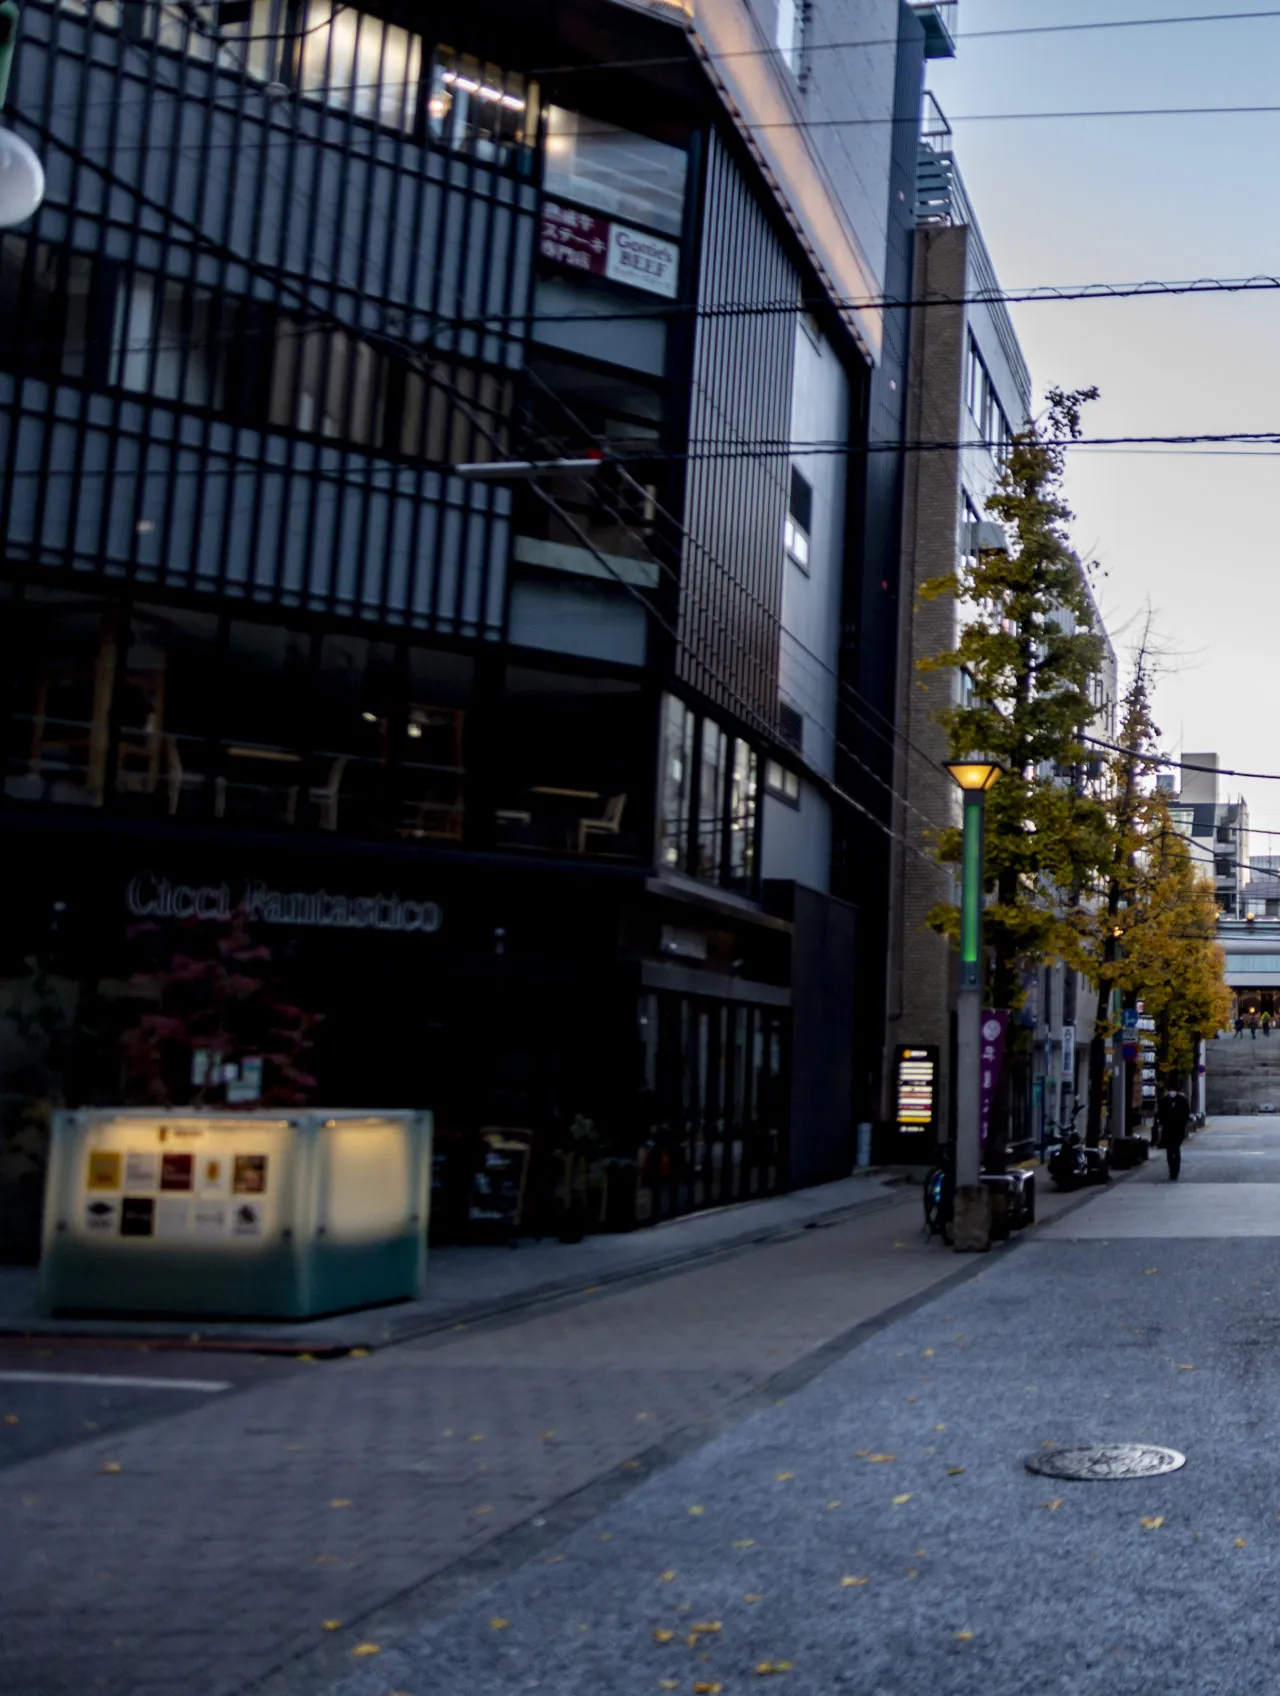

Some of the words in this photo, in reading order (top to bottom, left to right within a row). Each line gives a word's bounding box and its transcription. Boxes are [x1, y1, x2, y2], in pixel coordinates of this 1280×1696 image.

[540, 221, 606, 254] ステーキ
[620, 250, 668, 277] BEEF
[243, 876, 444, 933] Fantastico
